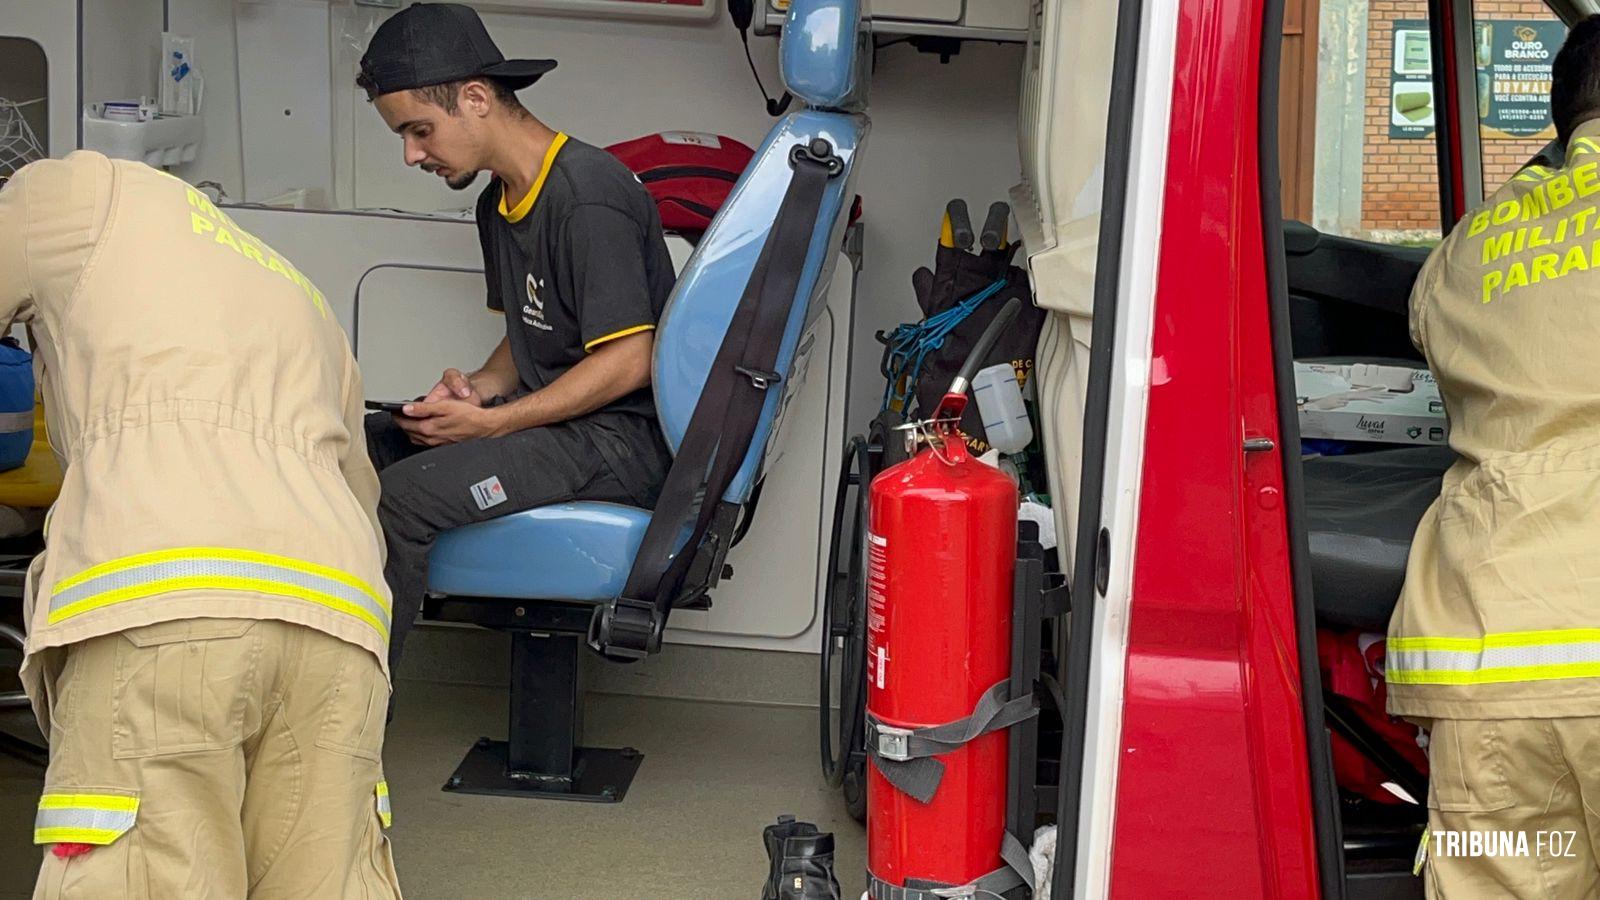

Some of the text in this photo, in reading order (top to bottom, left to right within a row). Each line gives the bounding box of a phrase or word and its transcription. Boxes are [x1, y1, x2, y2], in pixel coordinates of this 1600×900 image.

[1511, 41, 1543, 50] OURO
[1504, 49, 1549, 59] BRANCO
[1494, 81, 1551, 93] DRYWAL
